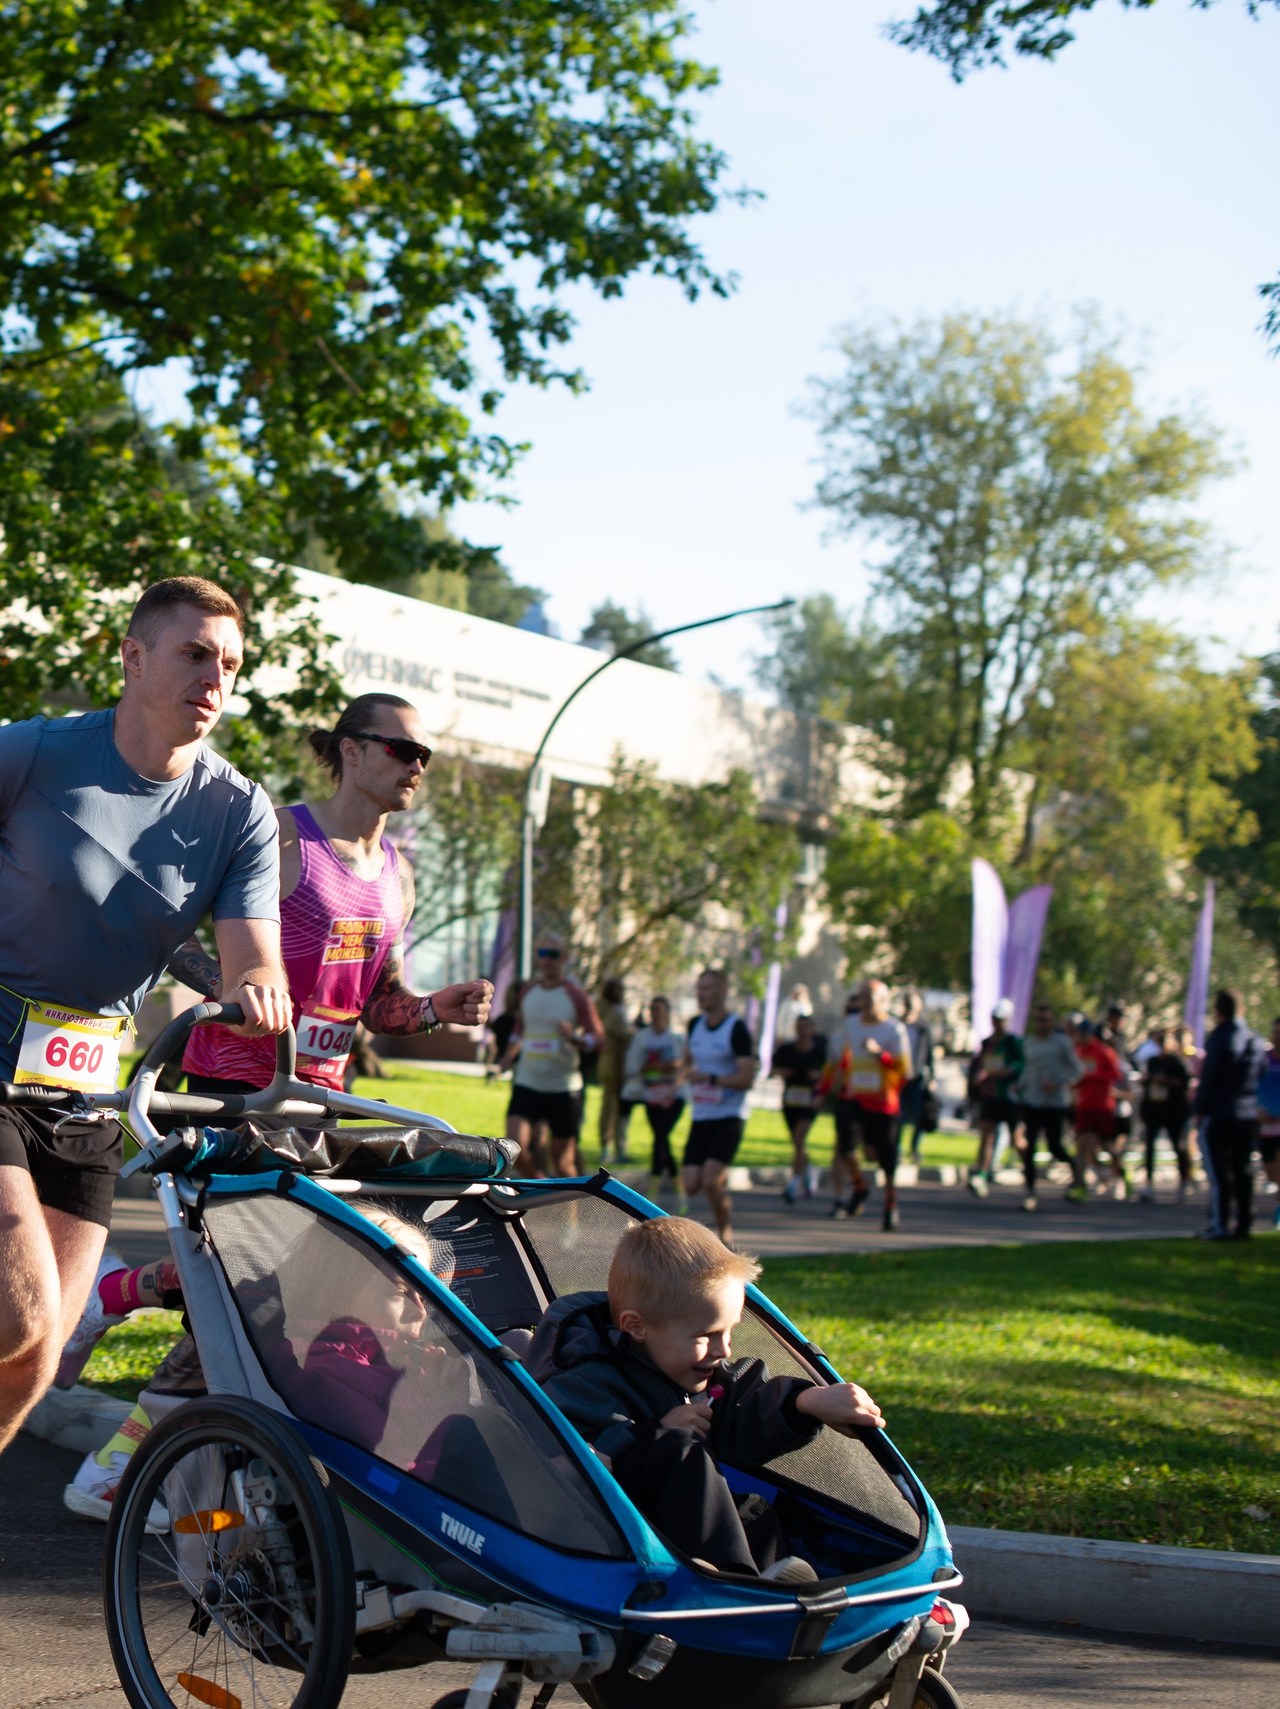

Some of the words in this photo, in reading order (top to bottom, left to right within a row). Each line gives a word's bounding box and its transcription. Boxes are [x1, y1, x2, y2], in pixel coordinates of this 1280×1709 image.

[336, 921, 384, 935] БОЛЬШЕ
[343, 934, 365, 947] ЧЕМ
[324, 946, 373, 962] МОЖЕШЬ
[307, 1024, 352, 1054] 1048
[45, 1036, 104, 1074] 660
[440, 1511, 486, 1556] THULE
